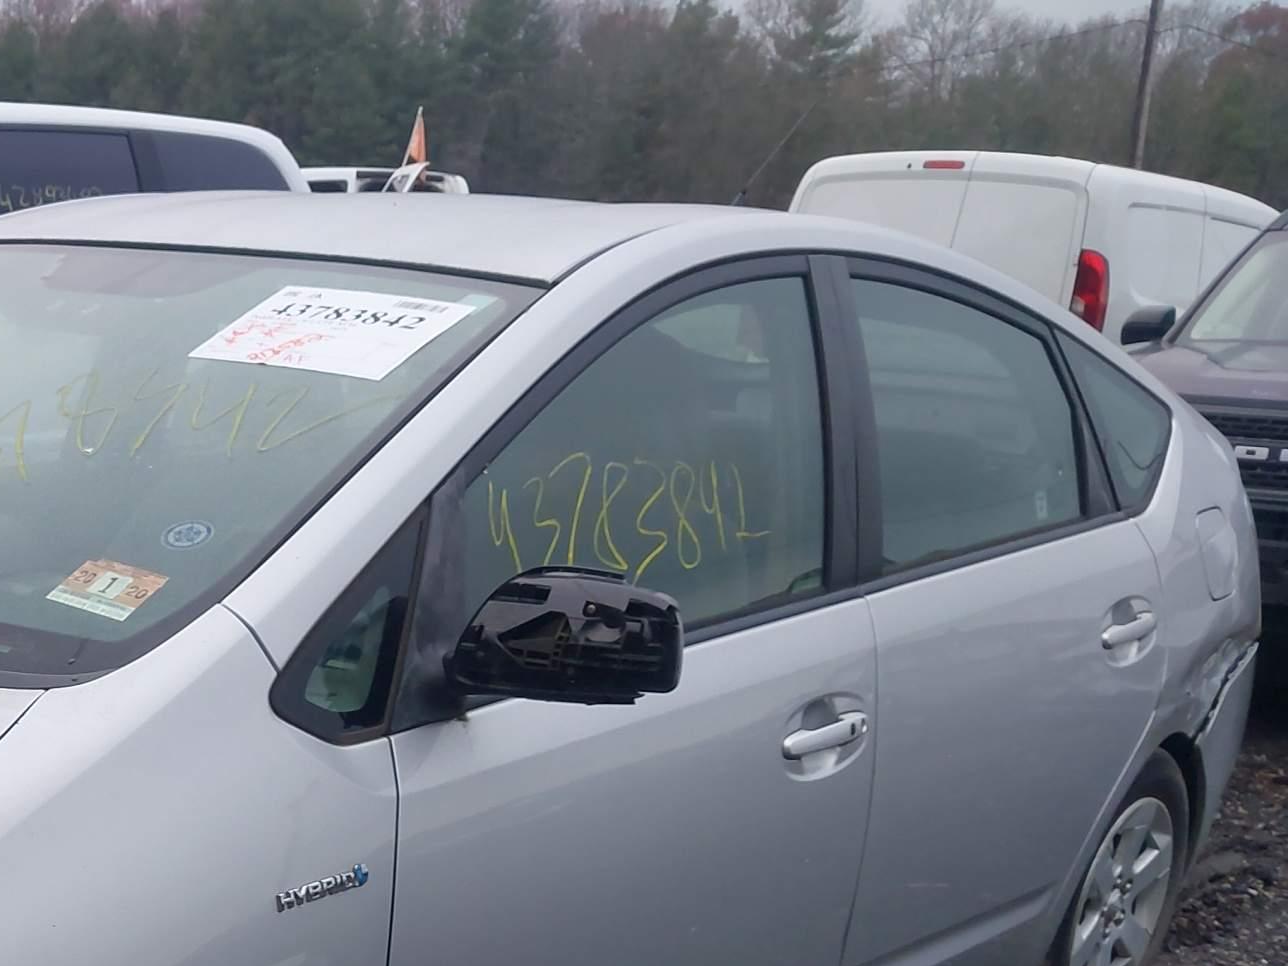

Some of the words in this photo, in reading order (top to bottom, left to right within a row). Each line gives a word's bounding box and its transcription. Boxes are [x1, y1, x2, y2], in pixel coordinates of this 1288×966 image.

[271, 301, 427, 331] 43783842
[73, 569, 97, 584] 20
[98, 577, 119, 594] 1
[125, 585, 150, 600] 20
[275, 871, 359, 913] HYBRID
